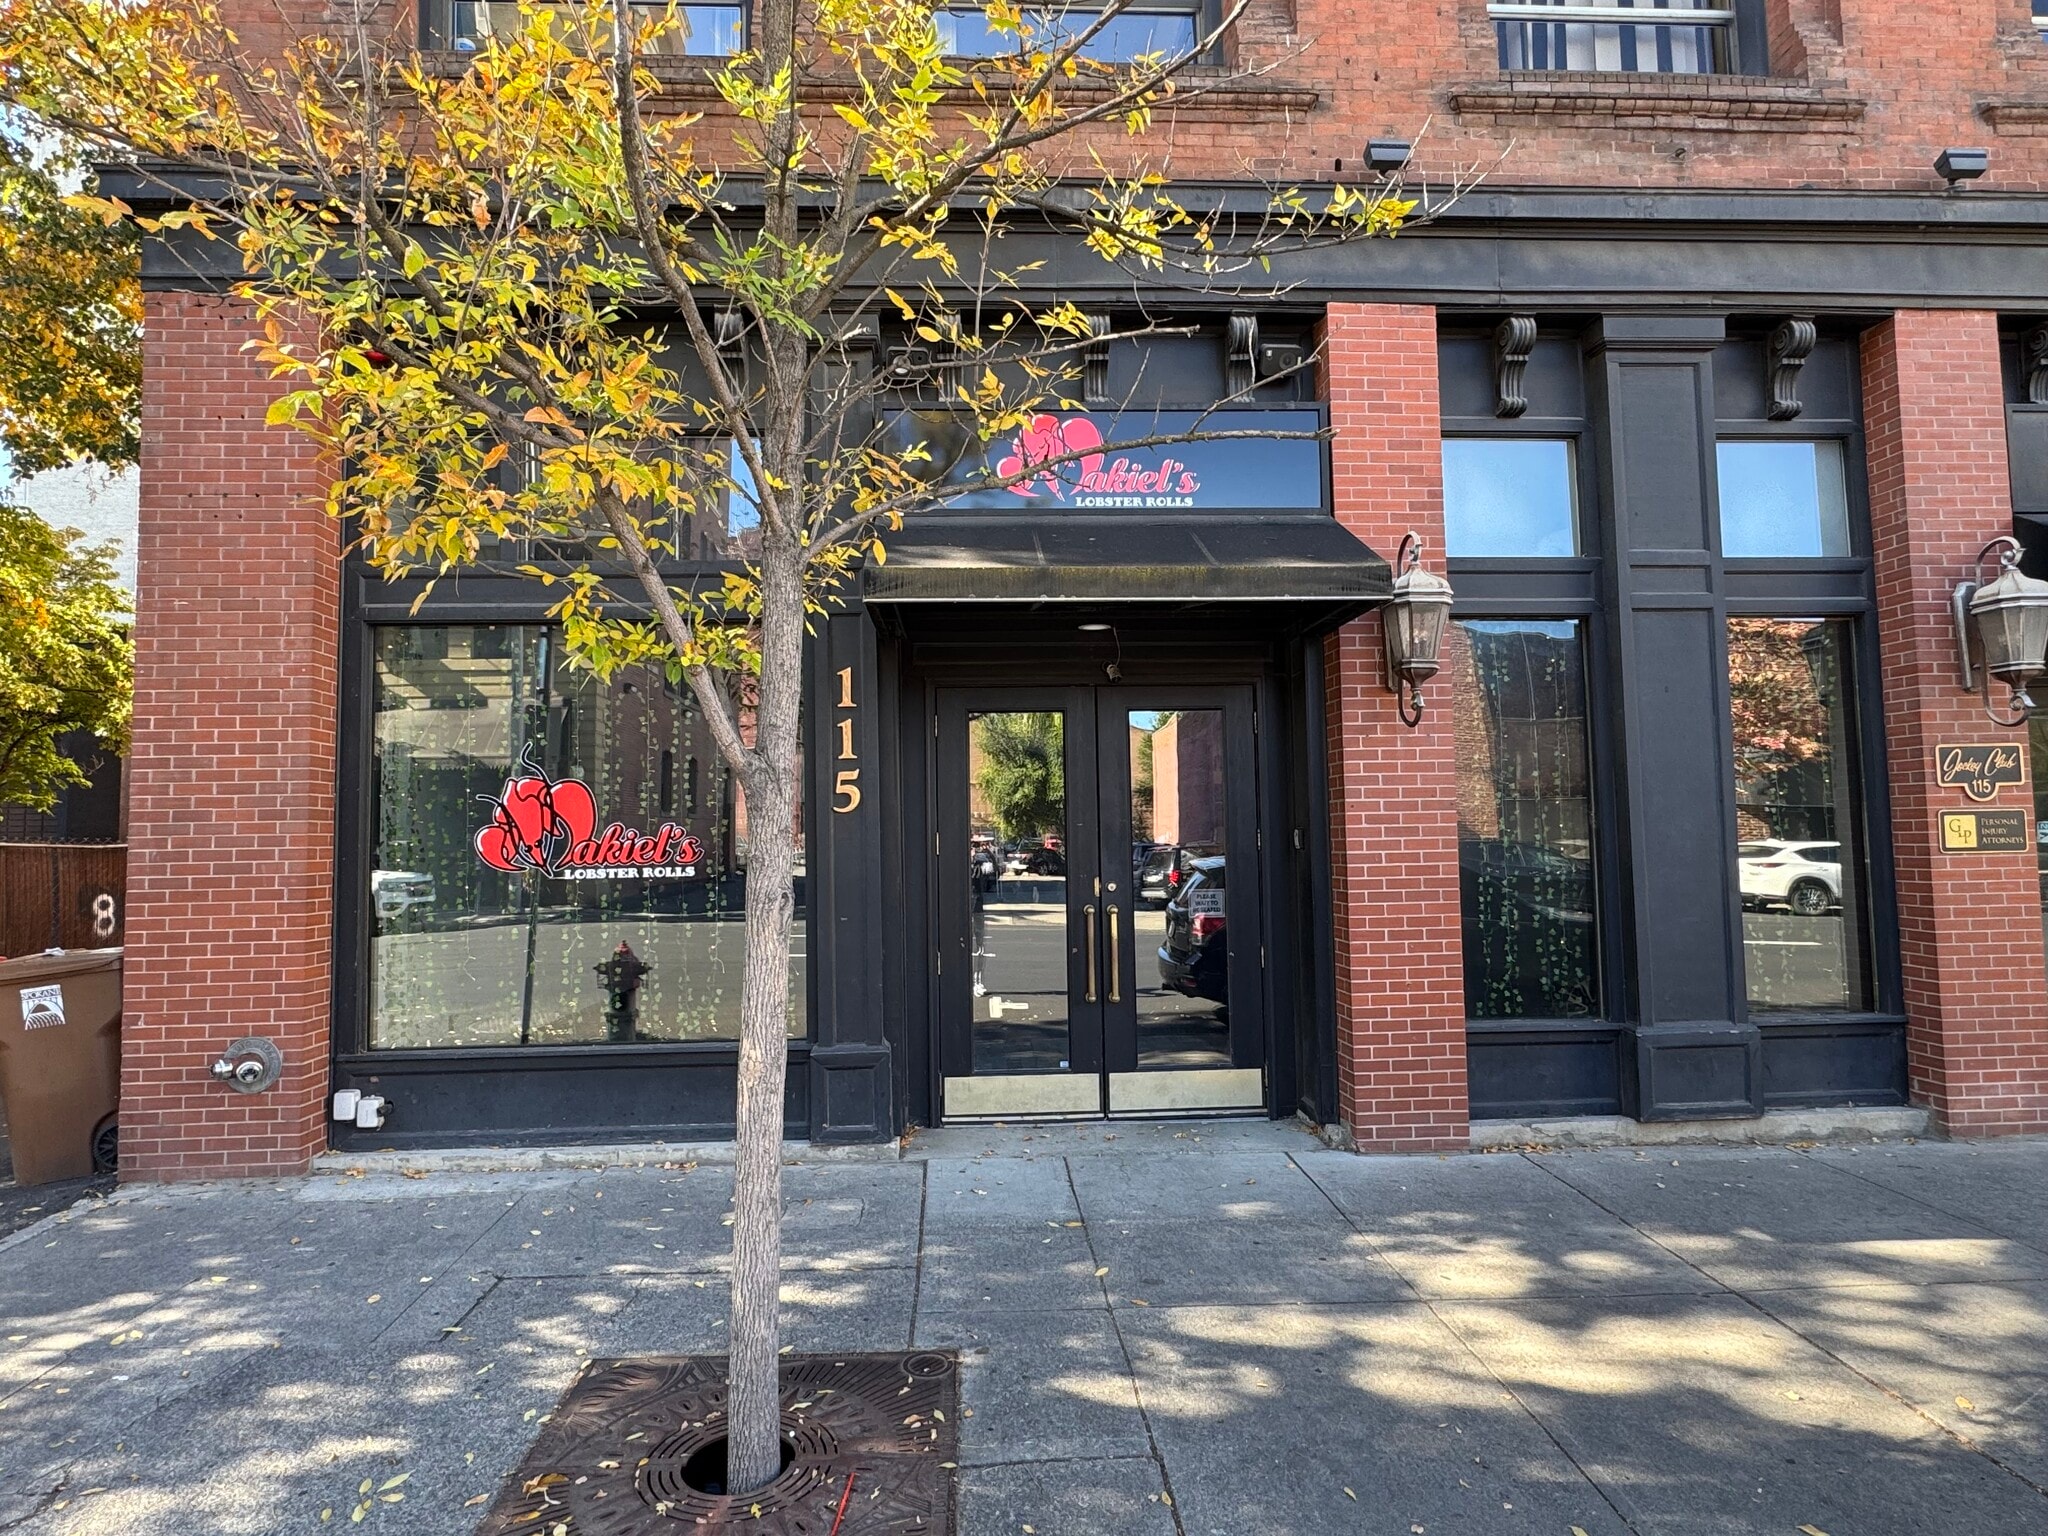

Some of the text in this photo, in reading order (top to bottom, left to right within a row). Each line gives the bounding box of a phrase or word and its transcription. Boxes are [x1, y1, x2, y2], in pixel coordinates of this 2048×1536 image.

[1075, 496, 1193, 507] LOBSTER ROLLS
[832, 666, 861, 813] 115
[1943, 748, 2017, 781] Jockey Club
[1972, 779, 1991, 793] 115
[1981, 827, 2007, 836] INJURY
[1981, 836, 2024, 844] ATTORNEYS
[564, 866, 696, 880] LOBSTER ROLLS
[92, 893, 115, 937] 8
